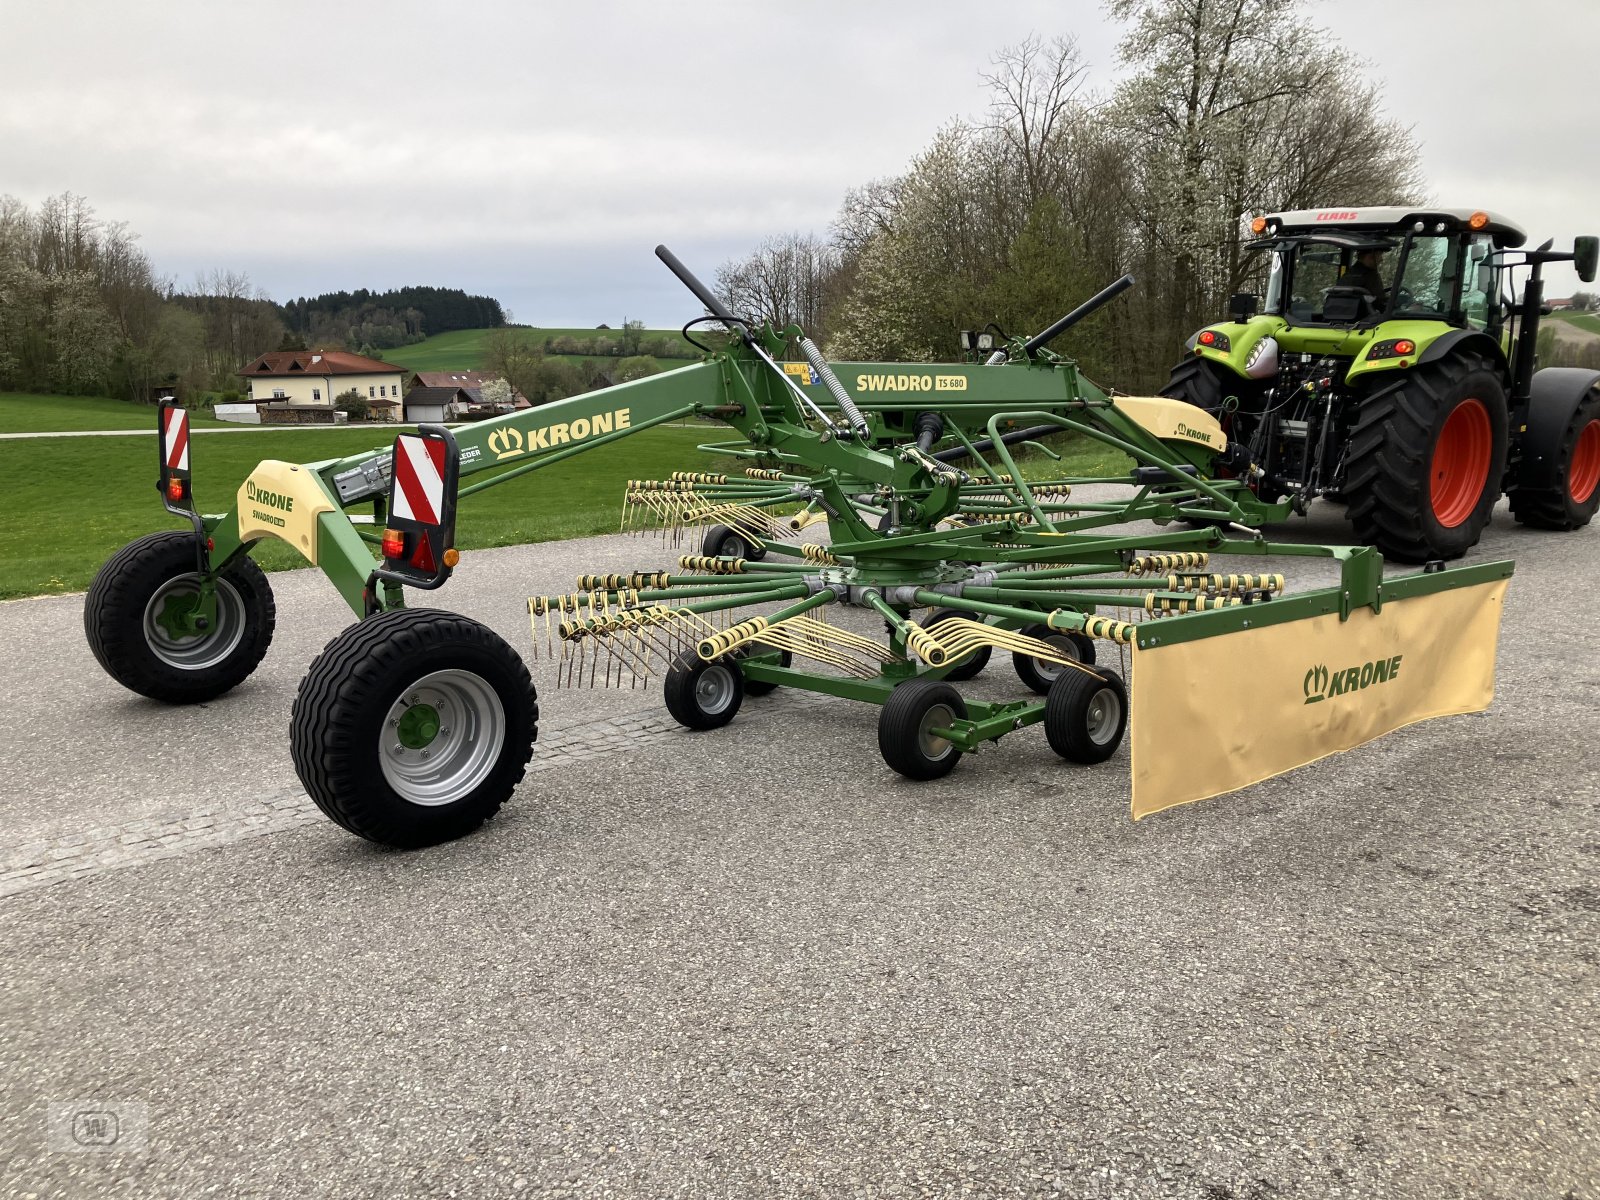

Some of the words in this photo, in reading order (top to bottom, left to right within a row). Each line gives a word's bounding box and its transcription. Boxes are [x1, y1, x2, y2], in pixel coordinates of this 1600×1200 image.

[1316, 211, 1359, 221] CLAAS
[856, 374, 933, 391] SWADRO
[939, 379, 948, 388] TS
[950, 379, 964, 388] 680
[527, 407, 631, 451] KRONE
[1186, 428, 1212, 442] KRONE
[256, 489, 294, 512] KRONE
[252, 509, 274, 524] SWADRO
[1327, 654, 1403, 698] KRONE
